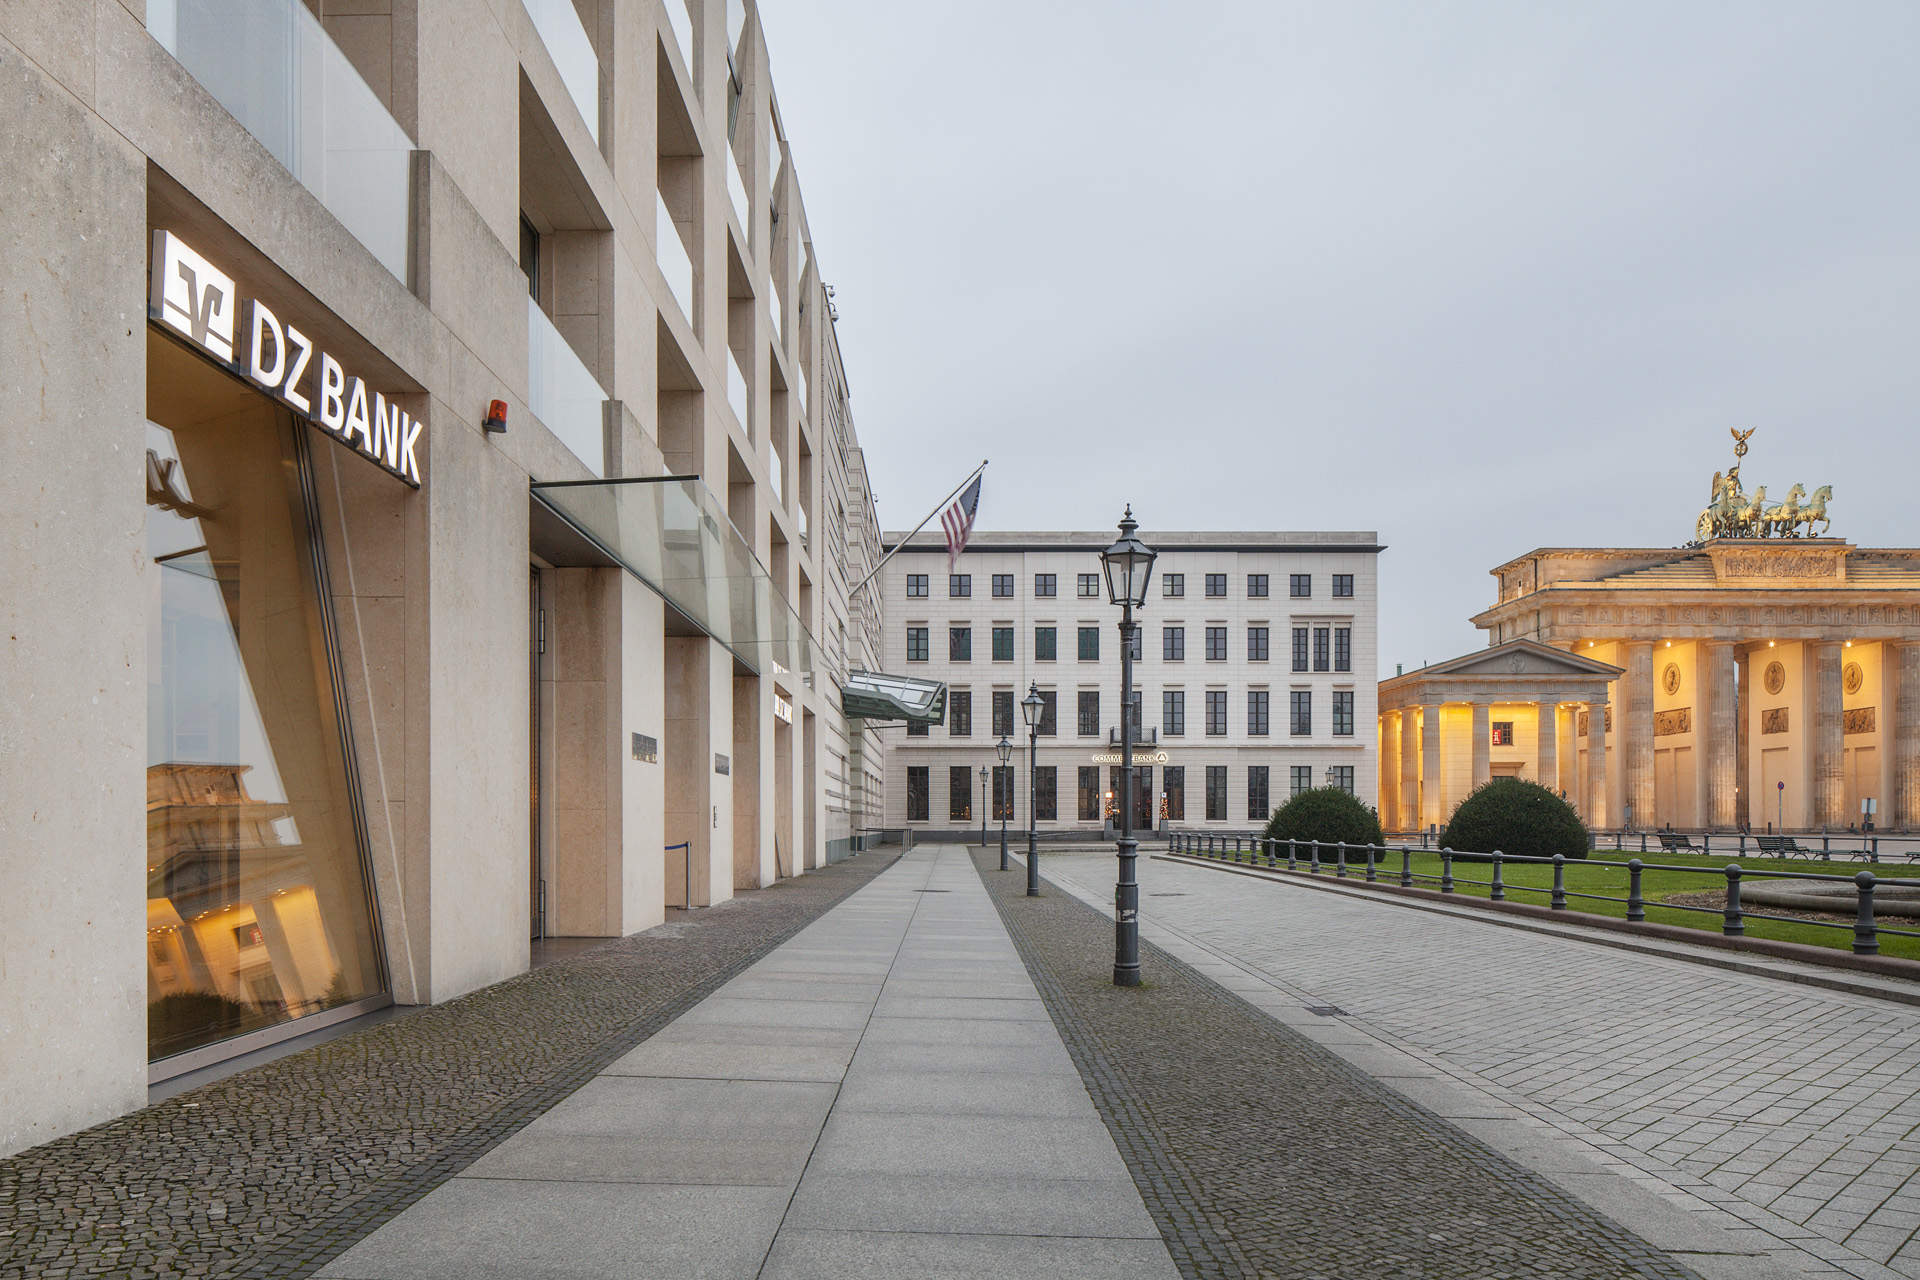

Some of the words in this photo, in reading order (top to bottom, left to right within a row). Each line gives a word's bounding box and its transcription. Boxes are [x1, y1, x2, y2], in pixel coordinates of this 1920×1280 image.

[247, 299, 313, 413] DZ
[319, 351, 424, 486] BANK
[1092, 754, 1156, 763] COMMEBANK
